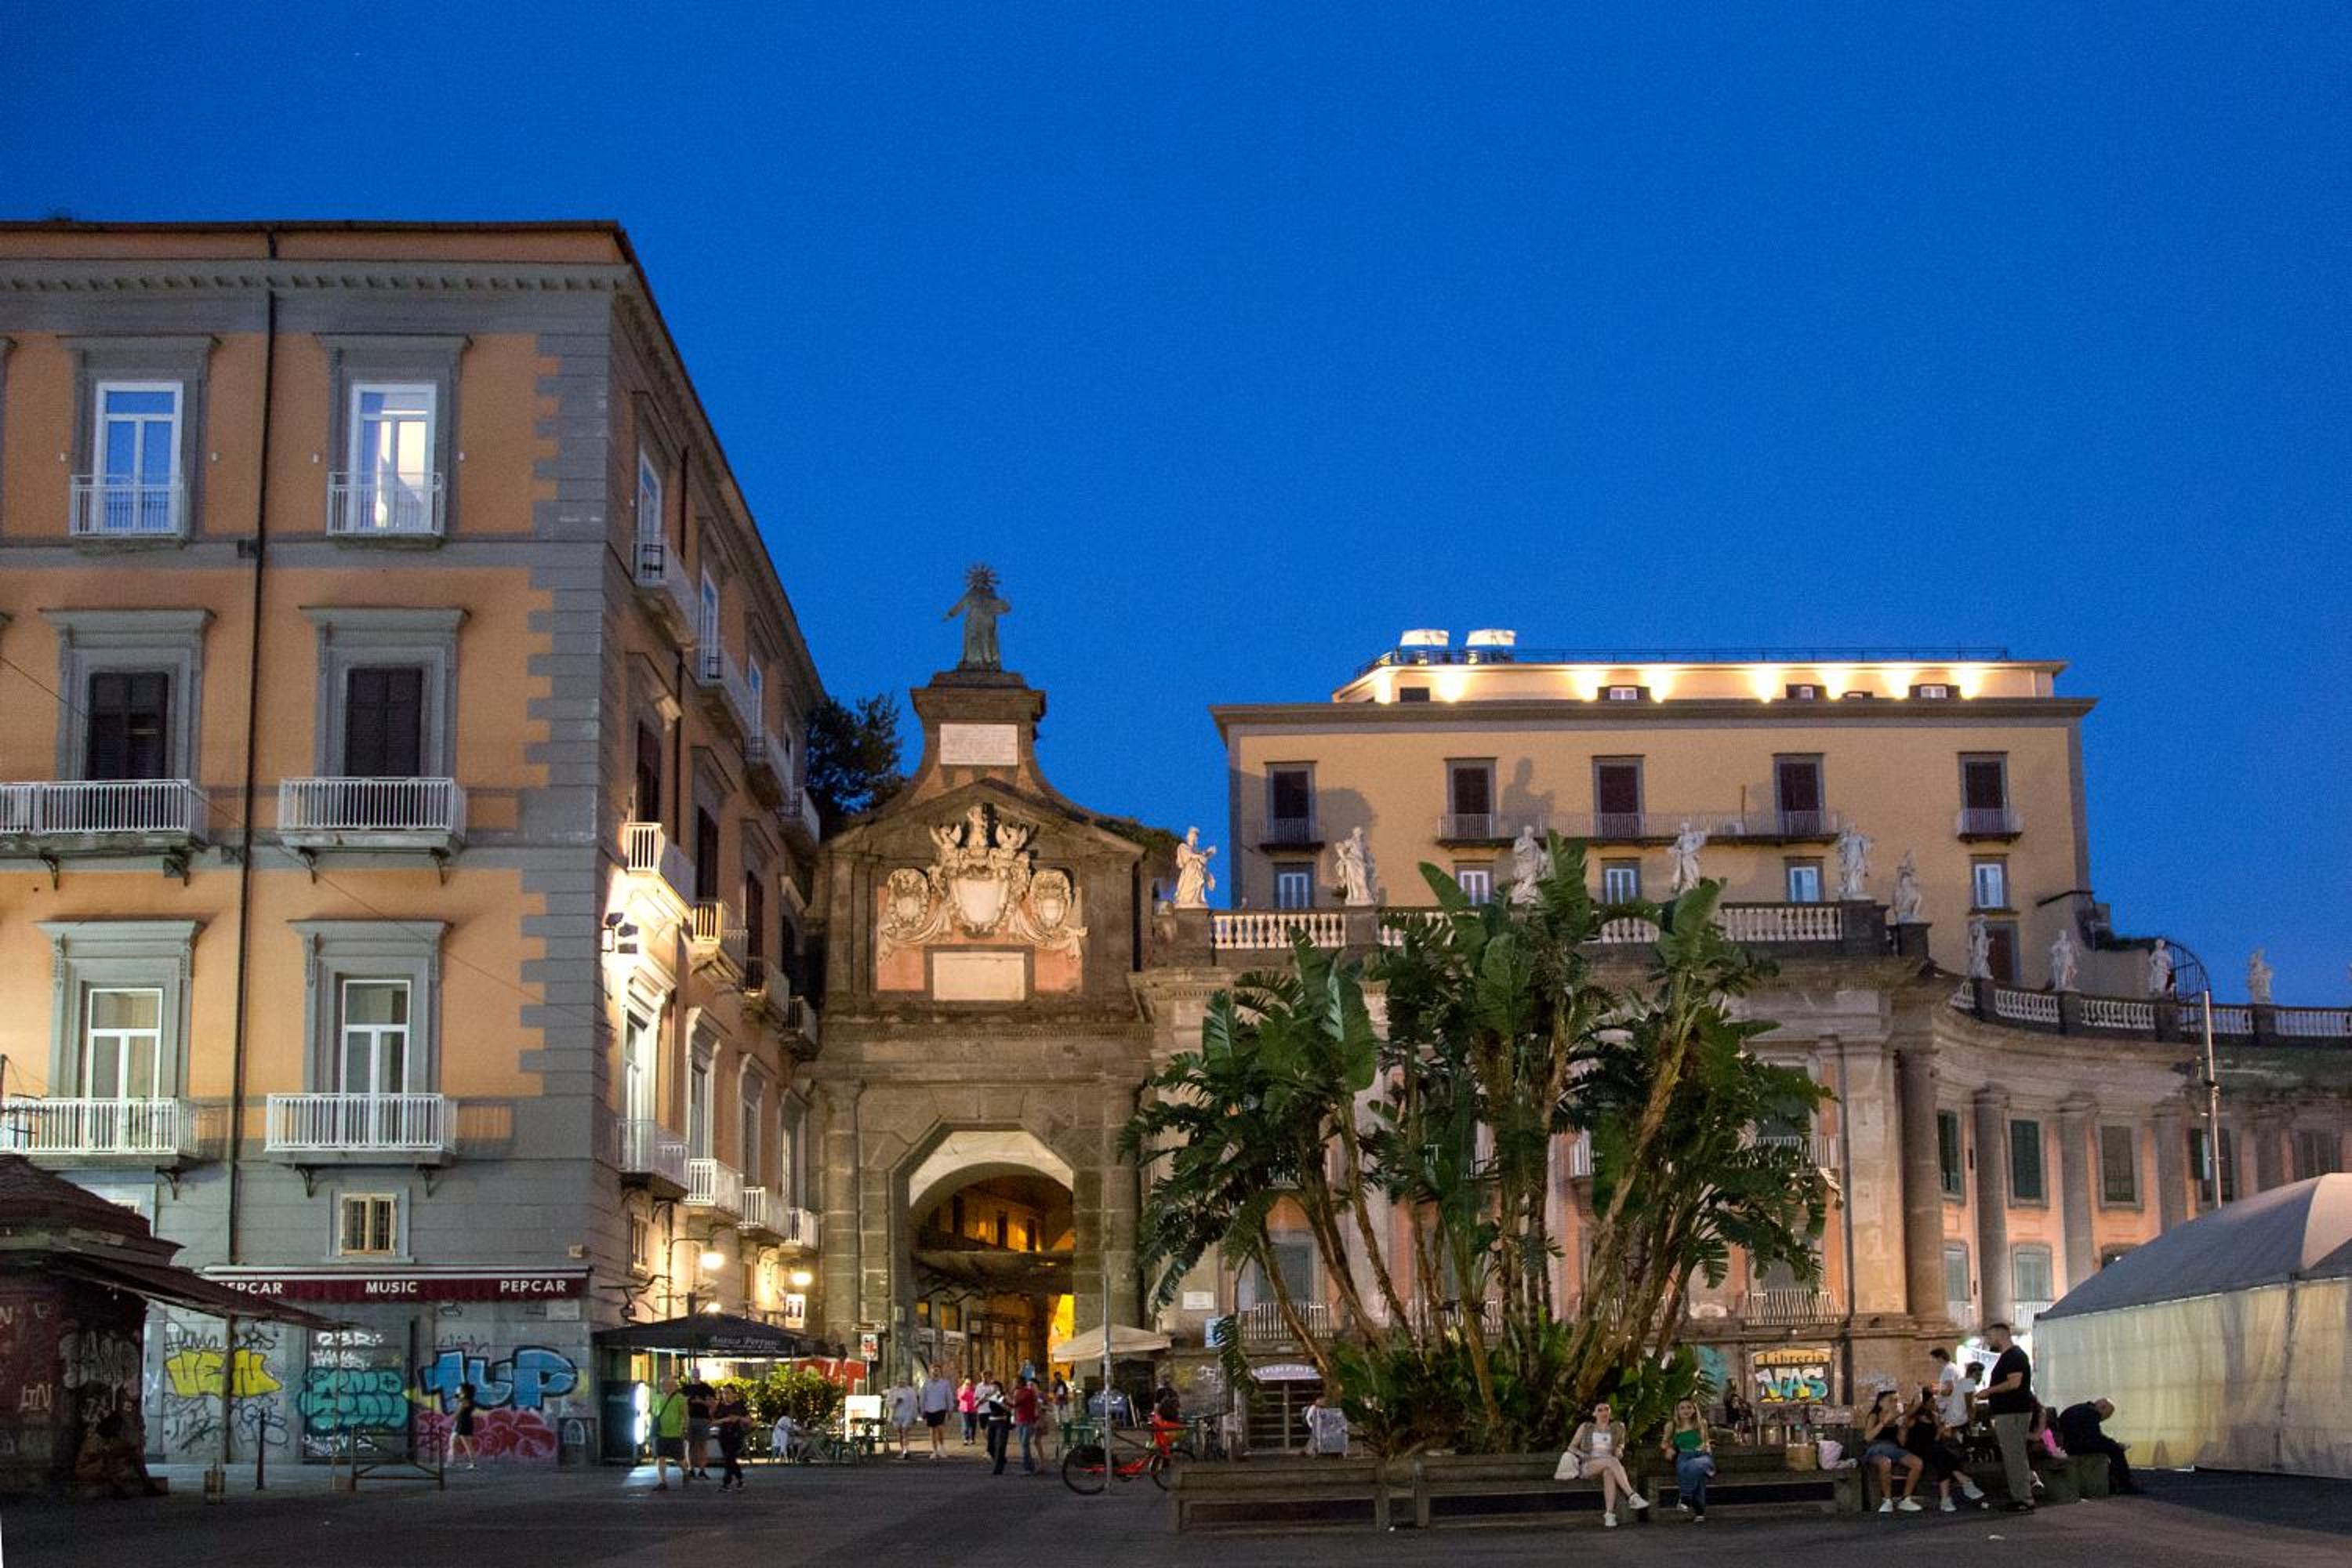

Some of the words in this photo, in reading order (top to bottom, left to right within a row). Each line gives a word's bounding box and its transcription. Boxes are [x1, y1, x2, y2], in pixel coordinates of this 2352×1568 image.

[365, 1281, 418, 1293] MUSIC
[499, 1280, 566, 1292] PEPCAR
[1763, 1352, 1824, 1364] Libreria
